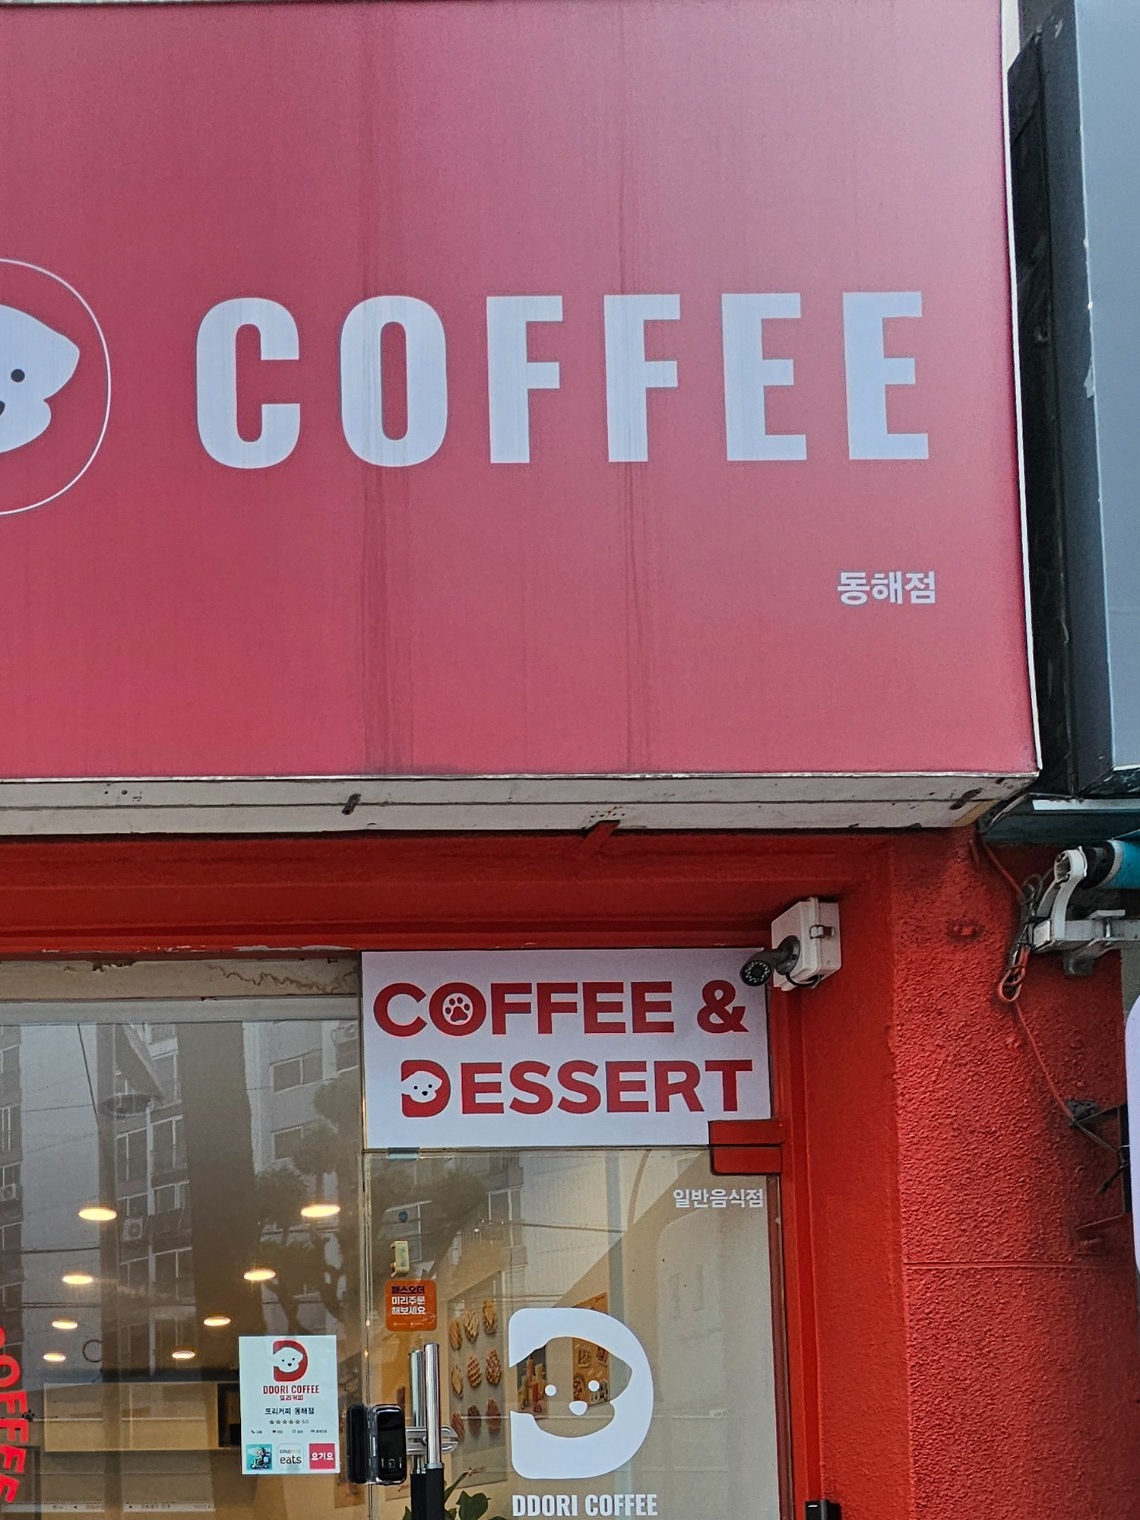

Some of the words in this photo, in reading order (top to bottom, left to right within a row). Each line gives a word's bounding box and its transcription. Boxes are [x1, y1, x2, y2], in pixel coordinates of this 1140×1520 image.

[194, 291, 930, 470] COFFEE
[836, 570, 937, 605] 동해점
[372, 980, 675, 1037] COFFEE
[696, 979, 749, 1034] &
[400, 1058, 754, 1118] DESSERT
[672, 1187, 765, 1209] 일반음식점
[391, 1296, 426, 1305] 미리주문
[263, 1384, 289, 1395] DDORI
[291, 1384, 320, 1394] COFFEE
[264, 1407, 292, 1416] 또리커피
[294, 1406, 315, 1415] 동해점
[279, 1455, 302, 1465] eats
[310, 1452, 334, 1461] 요기요
[511, 1494, 578, 1517] DDORI
[584, 1494, 658, 1517] COFFEE
